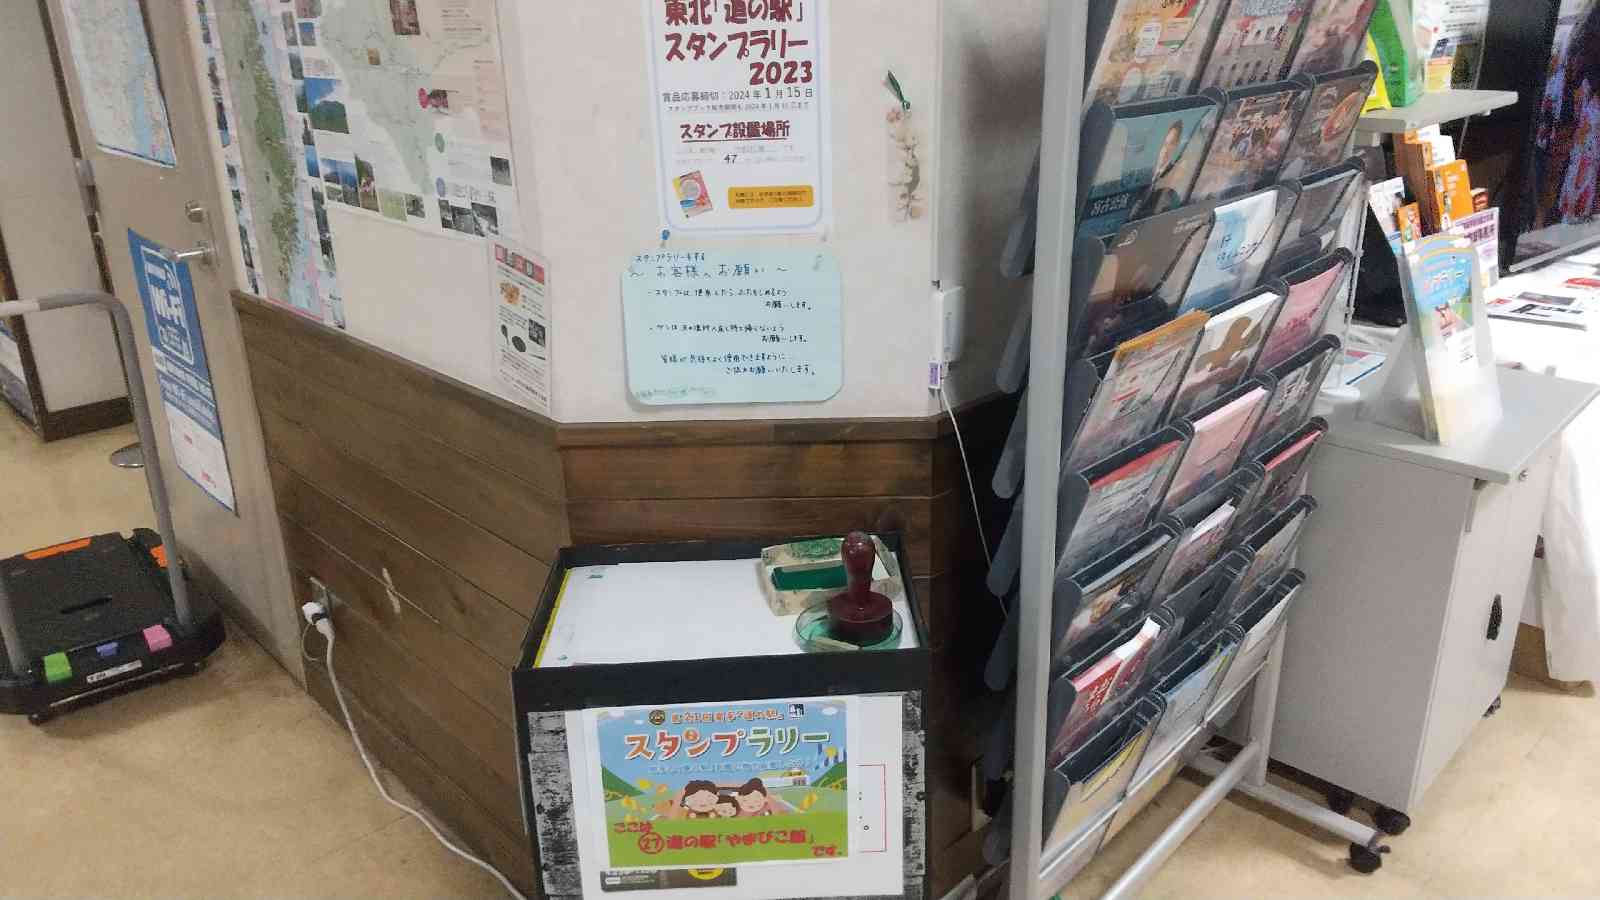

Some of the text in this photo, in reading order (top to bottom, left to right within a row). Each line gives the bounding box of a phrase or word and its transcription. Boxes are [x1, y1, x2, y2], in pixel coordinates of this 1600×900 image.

[665, 29, 809, 61] スタンプラリー
[749, 60, 813, 86] 2023
[679, 120, 791, 139] スタンプ設置場所
[723, 154, 738, 165] 47
[624, 726, 832, 761] スタンプラリー
